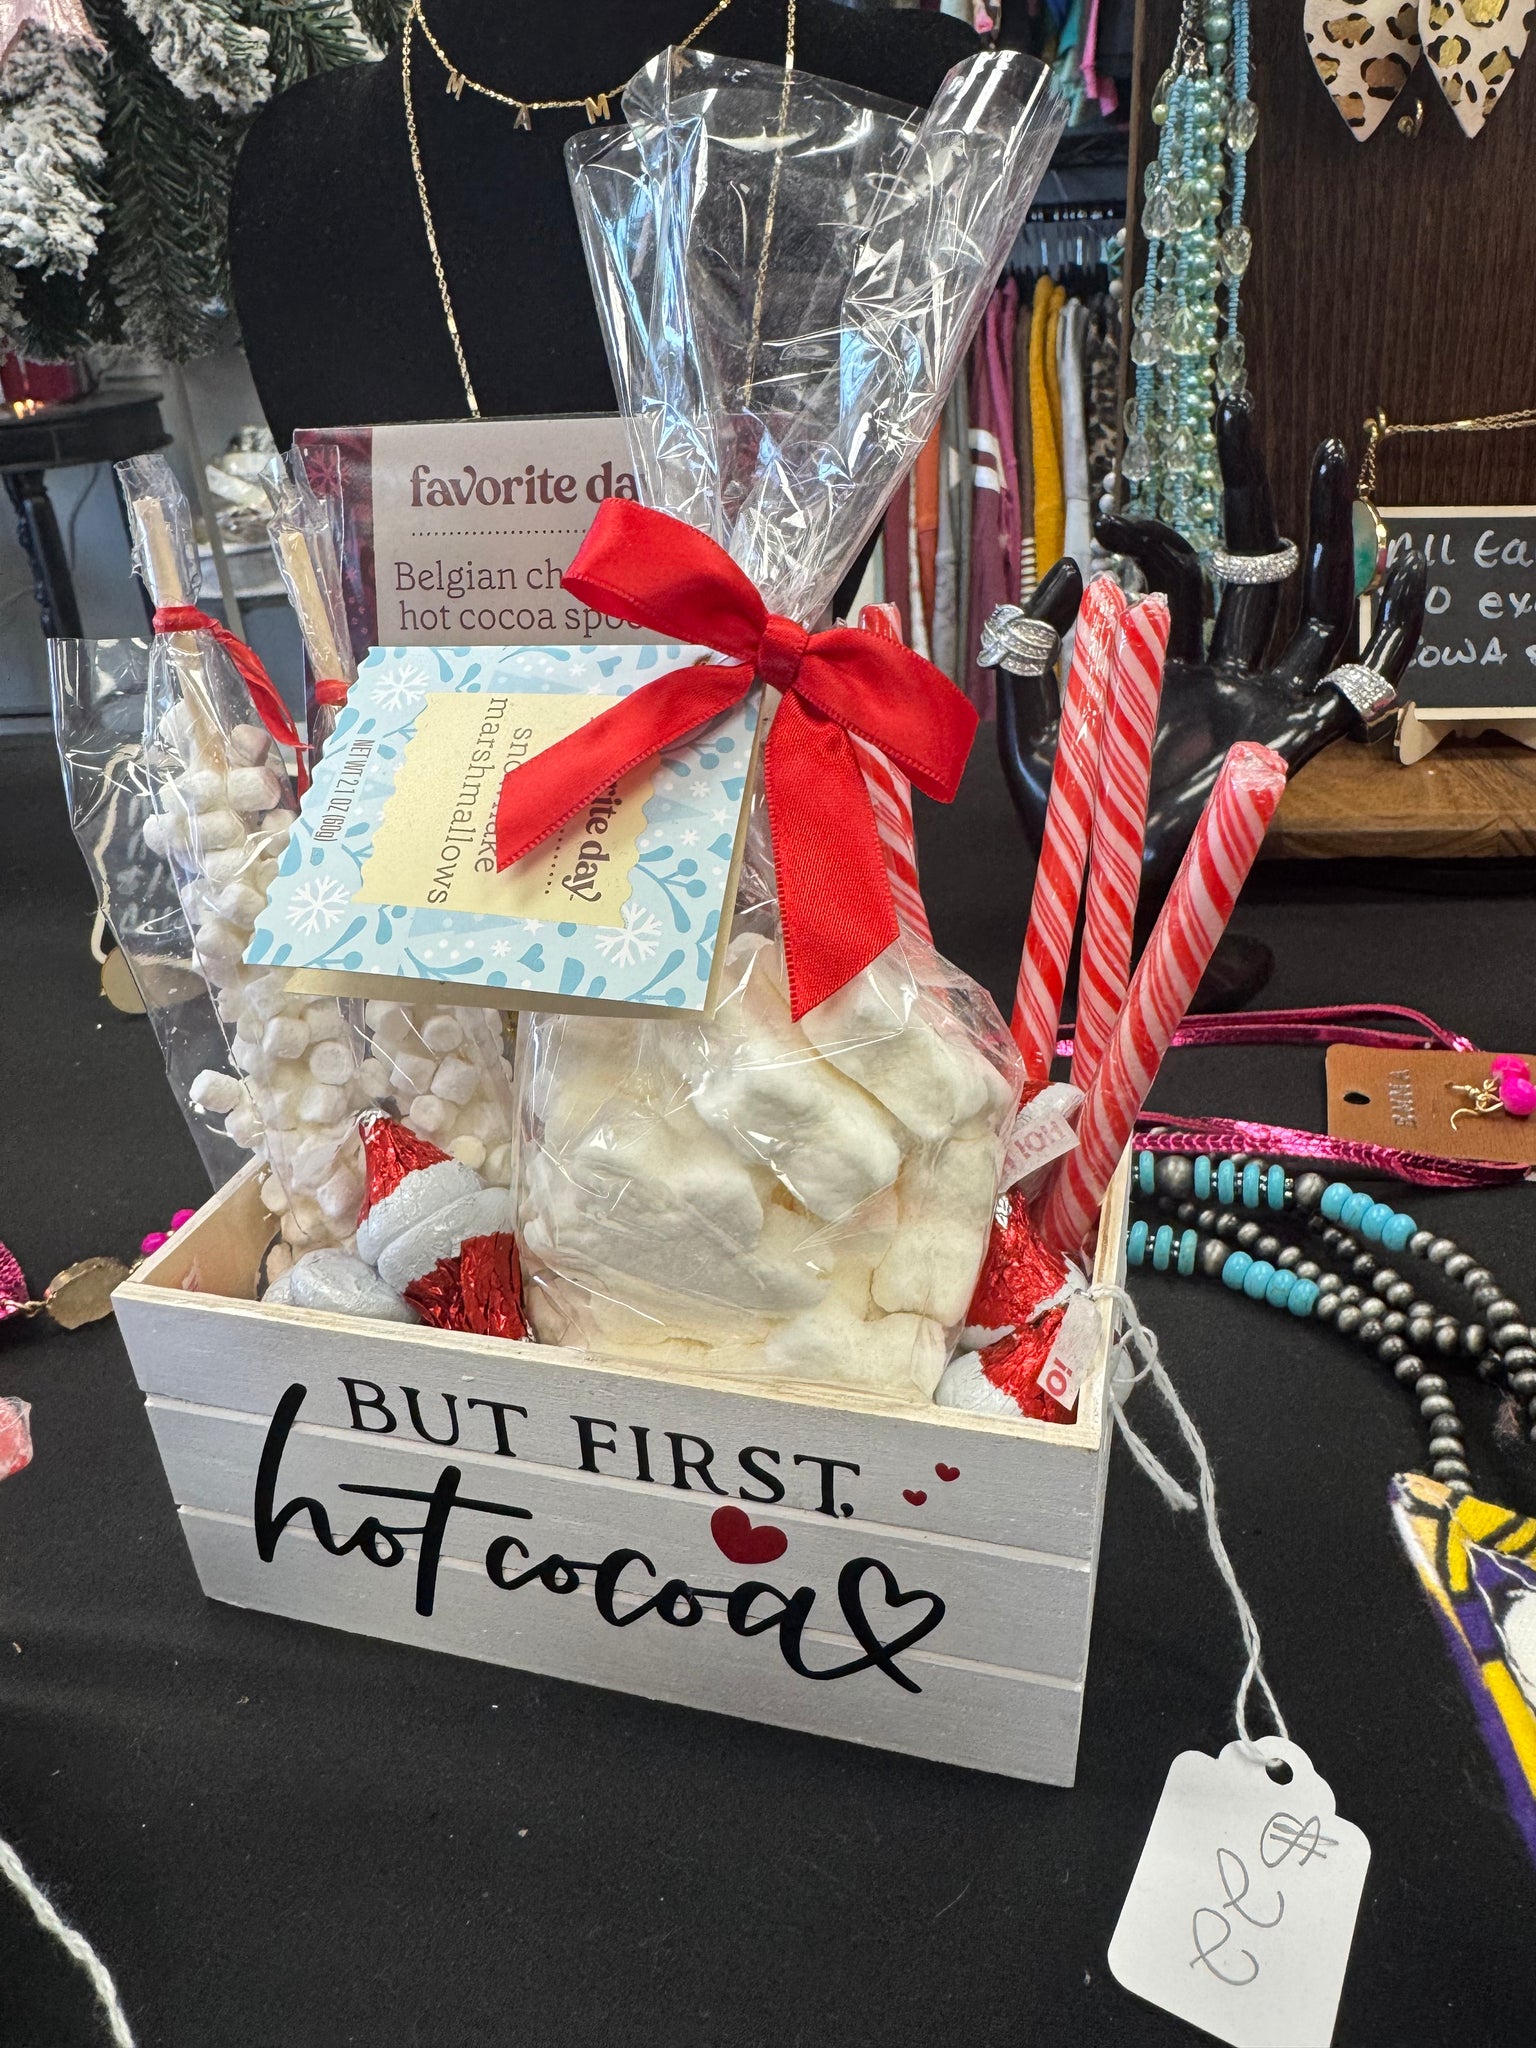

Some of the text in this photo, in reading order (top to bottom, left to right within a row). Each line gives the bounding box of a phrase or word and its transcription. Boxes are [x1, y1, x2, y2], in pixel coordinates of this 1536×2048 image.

[410, 464, 577, 507] favorite
[394, 560, 517, 598] Belgian
[400, 601, 451, 631] hot
[460, 607, 556, 630] cocoa
[348, 739, 376, 759] NET
[341, 760, 367, 777] WT
[327, 797, 352, 814] OZ
[427, 698, 509, 904] marshmallows
[313, 814, 346, 842] (60g)
[561, 839, 611, 903] day
[337, 1376, 528, 1457] BUT
[254, 1383, 946, 1694] hot cocoa
